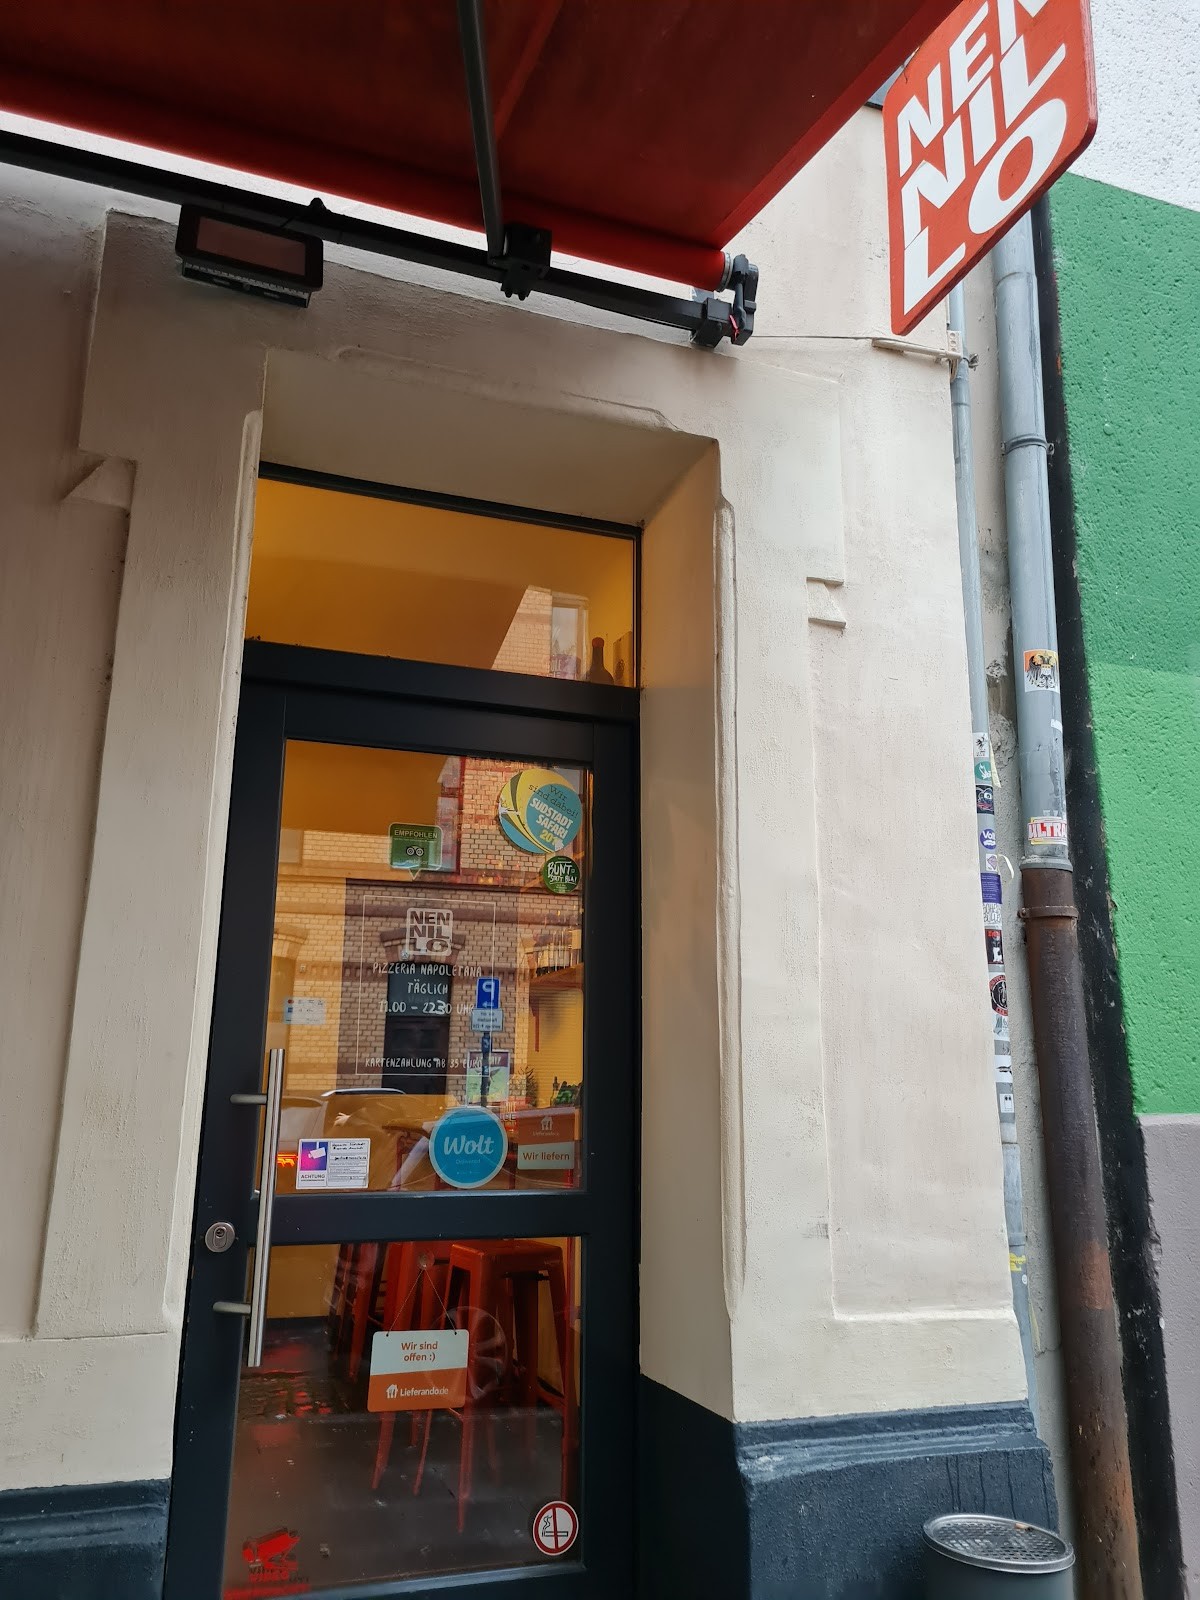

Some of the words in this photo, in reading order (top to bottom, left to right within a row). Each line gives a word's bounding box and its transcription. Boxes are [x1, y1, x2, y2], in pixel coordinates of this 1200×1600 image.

[901, 34, 1067, 249] NIL
[903, 97, 1068, 316] LO
[528, 784, 549, 800] sind
[549, 785, 567, 801] Wir
[394, 829, 438, 839] EMPFOHLEN
[535, 814, 569, 840] SAFARI
[410, 910, 452, 926] NEN
[409, 925, 451, 940] NIL
[408, 938, 449, 953] LO
[420, 963, 482, 977] NAPOLETANA
[365, 1056, 432, 1069] KARTENZAHLUNG
[449, 1058, 460, 1069] 35
[443, 1134, 495, 1156] Wolt
[522, 1151, 539, 1161] Wir
[541, 1151, 570, 1161] liefern
[400, 1341, 418, 1351] Wir
[419, 1340, 439, 1350] sind
[403, 1352, 427, 1362] offen
[400, 1386, 449, 1397] Lieferando.de
